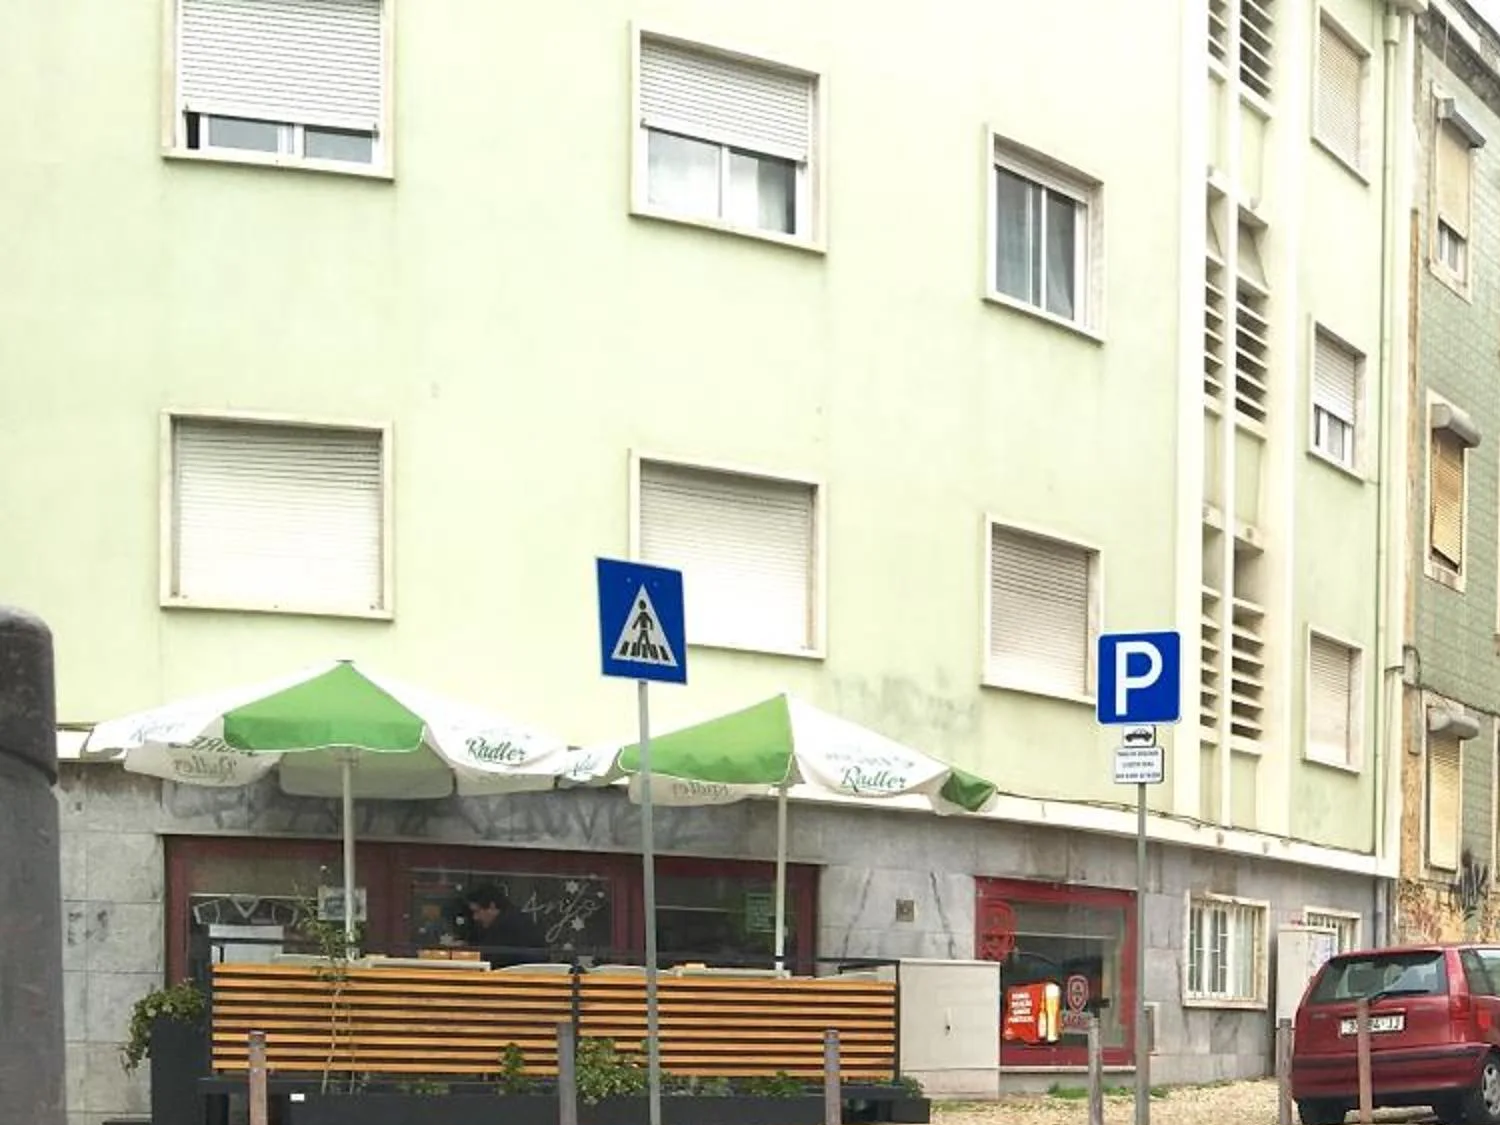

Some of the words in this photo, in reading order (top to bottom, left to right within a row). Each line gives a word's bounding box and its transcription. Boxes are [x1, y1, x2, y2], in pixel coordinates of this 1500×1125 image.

[1115, 641, 1163, 716] P
[465, 736, 527, 764] Radler
[840, 765, 907, 792] Radler
